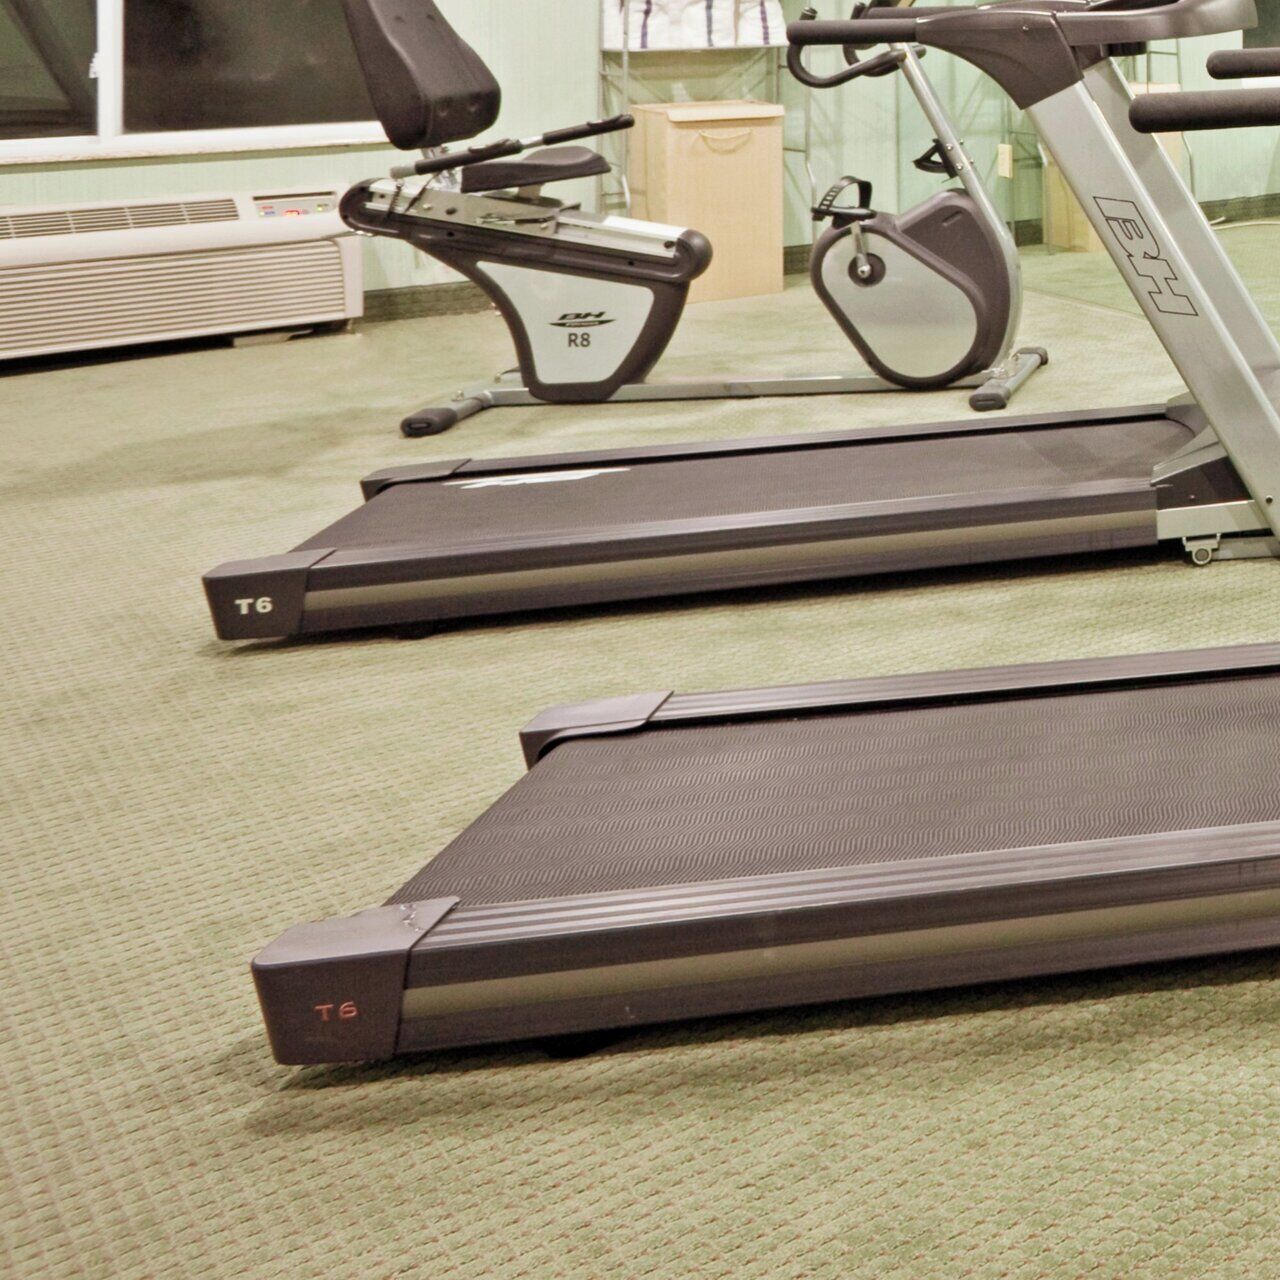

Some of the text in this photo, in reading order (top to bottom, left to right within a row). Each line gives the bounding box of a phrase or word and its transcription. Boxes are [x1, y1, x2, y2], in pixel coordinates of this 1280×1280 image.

[1093, 196, 1199, 316] BH
[568, 332, 591, 348] R8
[234, 596, 274, 615] T6
[313, 1000, 359, 1022] T6
